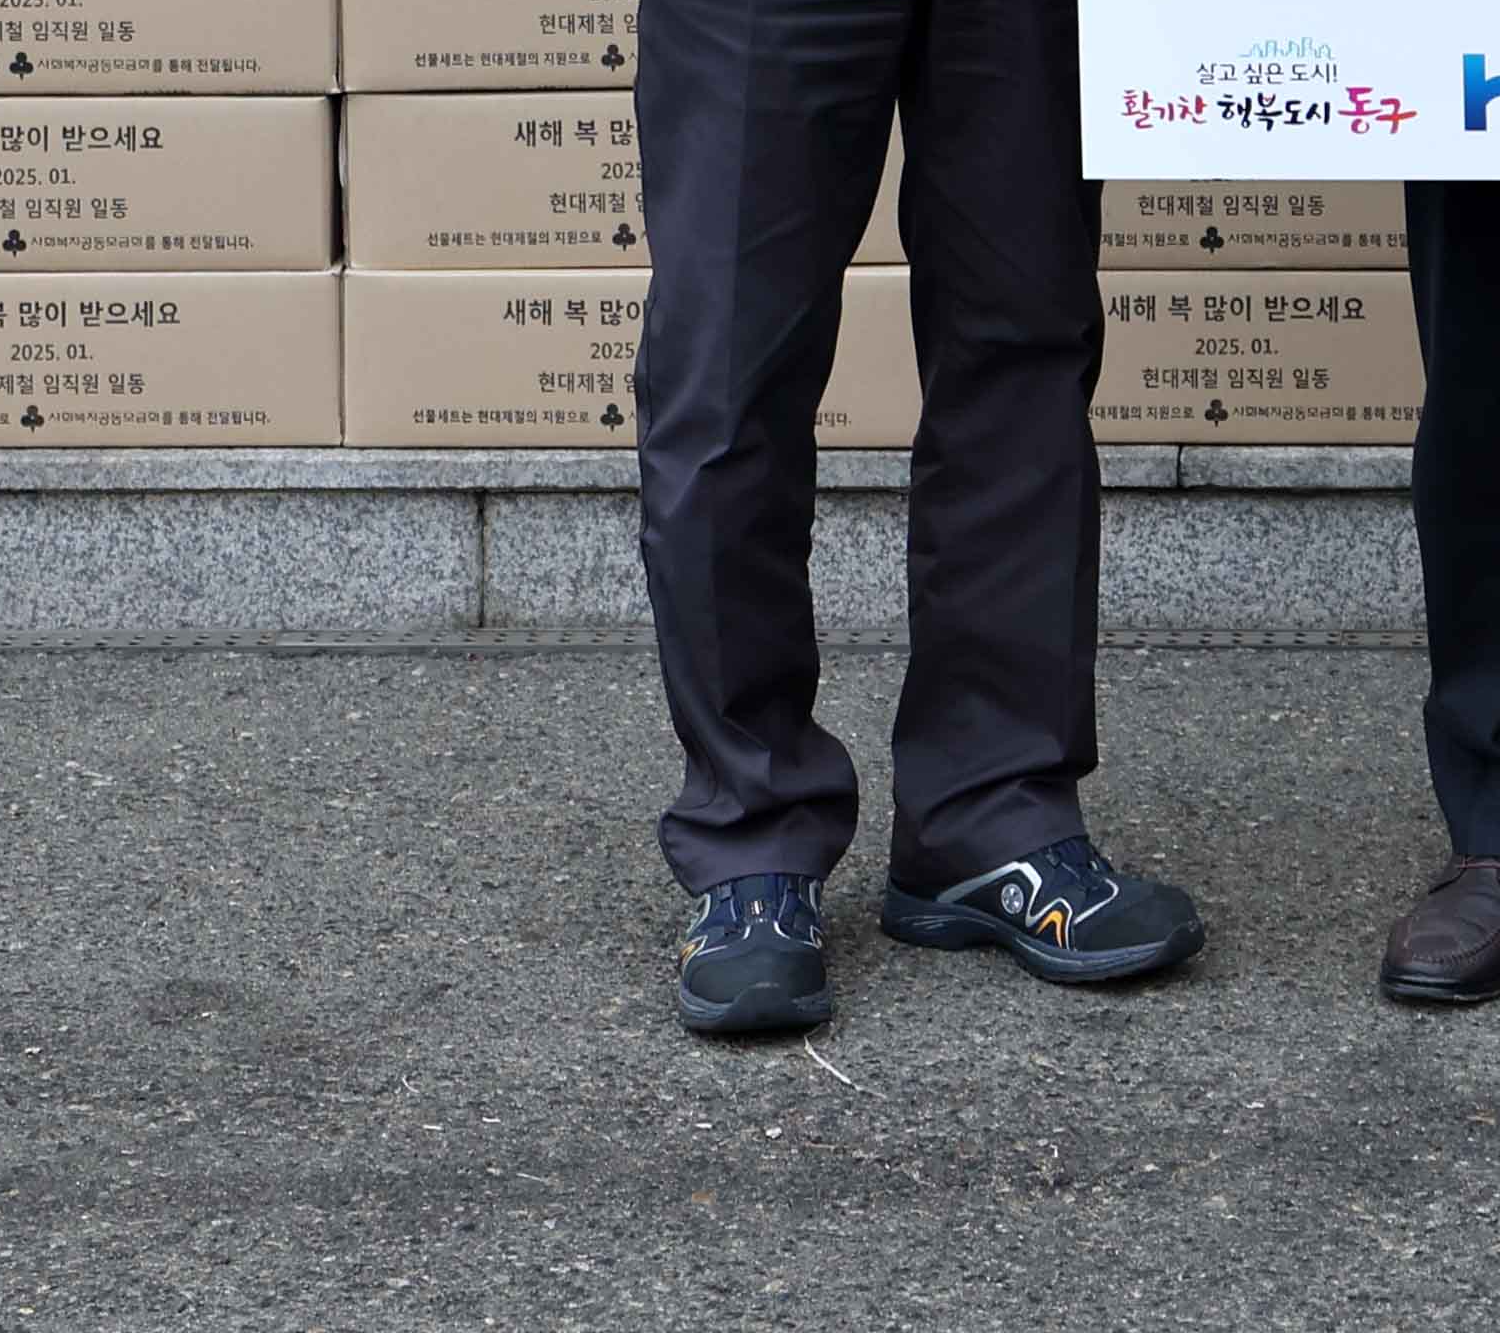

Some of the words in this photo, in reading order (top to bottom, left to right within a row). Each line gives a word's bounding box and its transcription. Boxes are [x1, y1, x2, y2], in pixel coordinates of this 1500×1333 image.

[1197, 64, 1237, 84] 살고
[1244, 63, 1284, 84] 싶은
[1291, 63, 1337, 83] 도시!
[1122, 90, 1207, 129] 활기찬
[1217, 92, 1330, 132] 행복도시
[1338, 87, 1417, 134] 동구
[18, 297, 66, 328] 많이
[79, 297, 180, 328] 받으세요
[10, 341, 60, 363] 2025.
[64, 343, 93, 364] 01.
[42, 373, 99, 395] 임직원
[108, 373, 146, 395] 일동
[178, 411, 202, 426] 통해
[206, 410, 270, 427] 전달됩니다.
